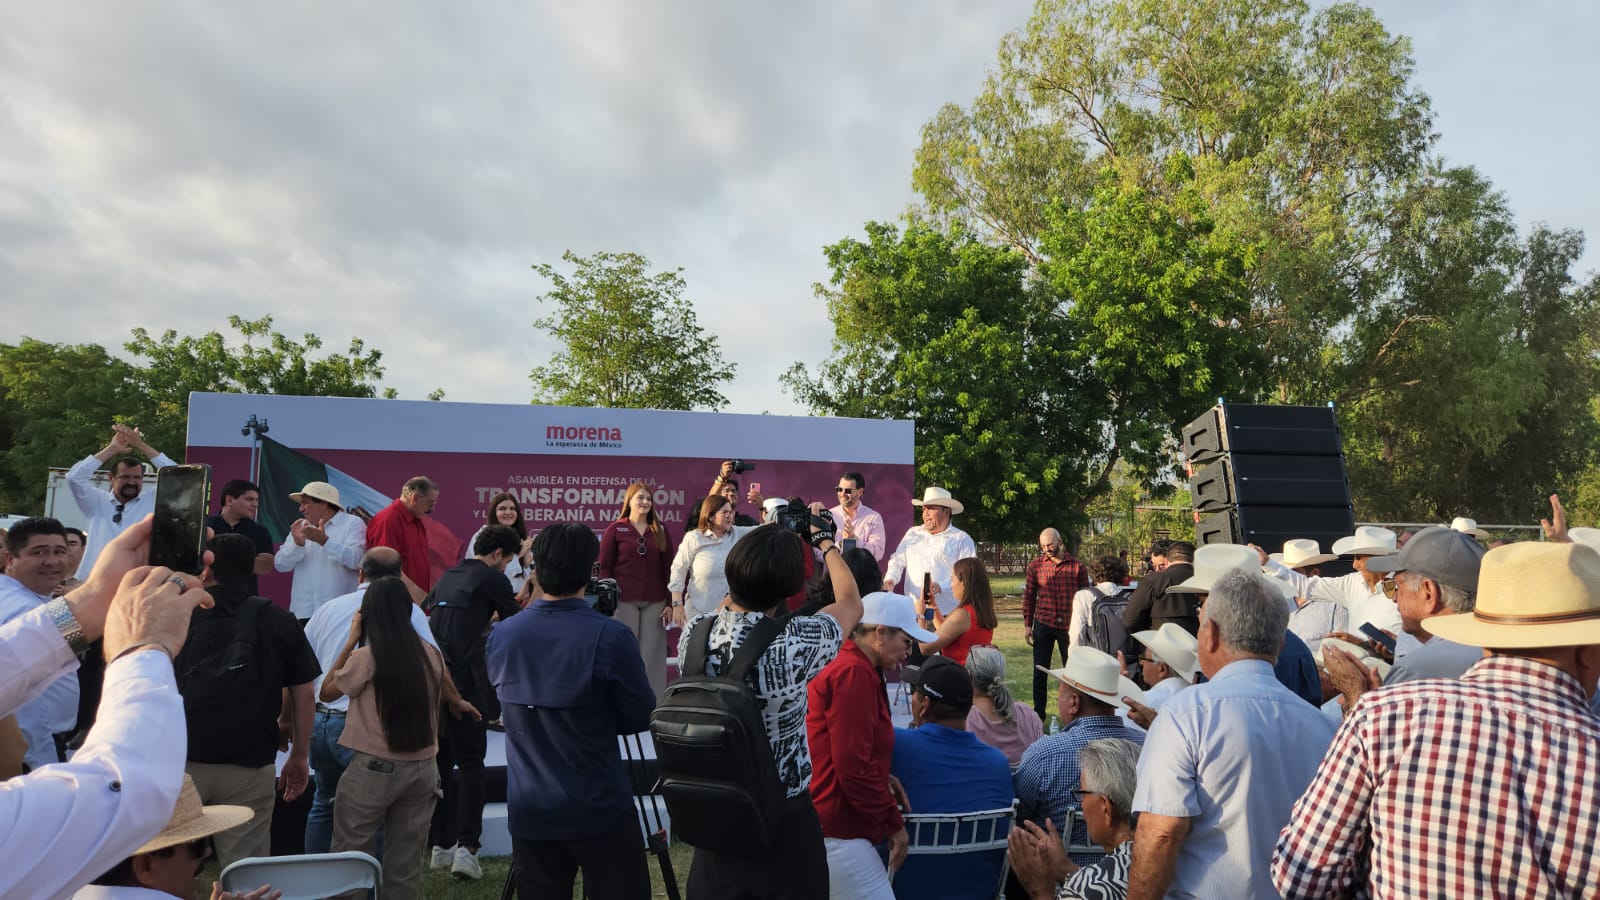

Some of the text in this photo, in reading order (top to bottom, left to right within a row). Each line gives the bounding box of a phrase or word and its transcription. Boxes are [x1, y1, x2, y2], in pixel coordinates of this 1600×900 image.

[545, 425, 622, 441] morena
[507, 475, 564, 485] ASAMBLEA
[566, 476, 580, 485] EN
[582, 476, 627, 486] DEFENSA
[629, 477, 643, 485] DE
[475, 484, 685, 506] TRANSFORMAÓN
[473, 505, 683, 523] Y L BERANÍA NANAL
